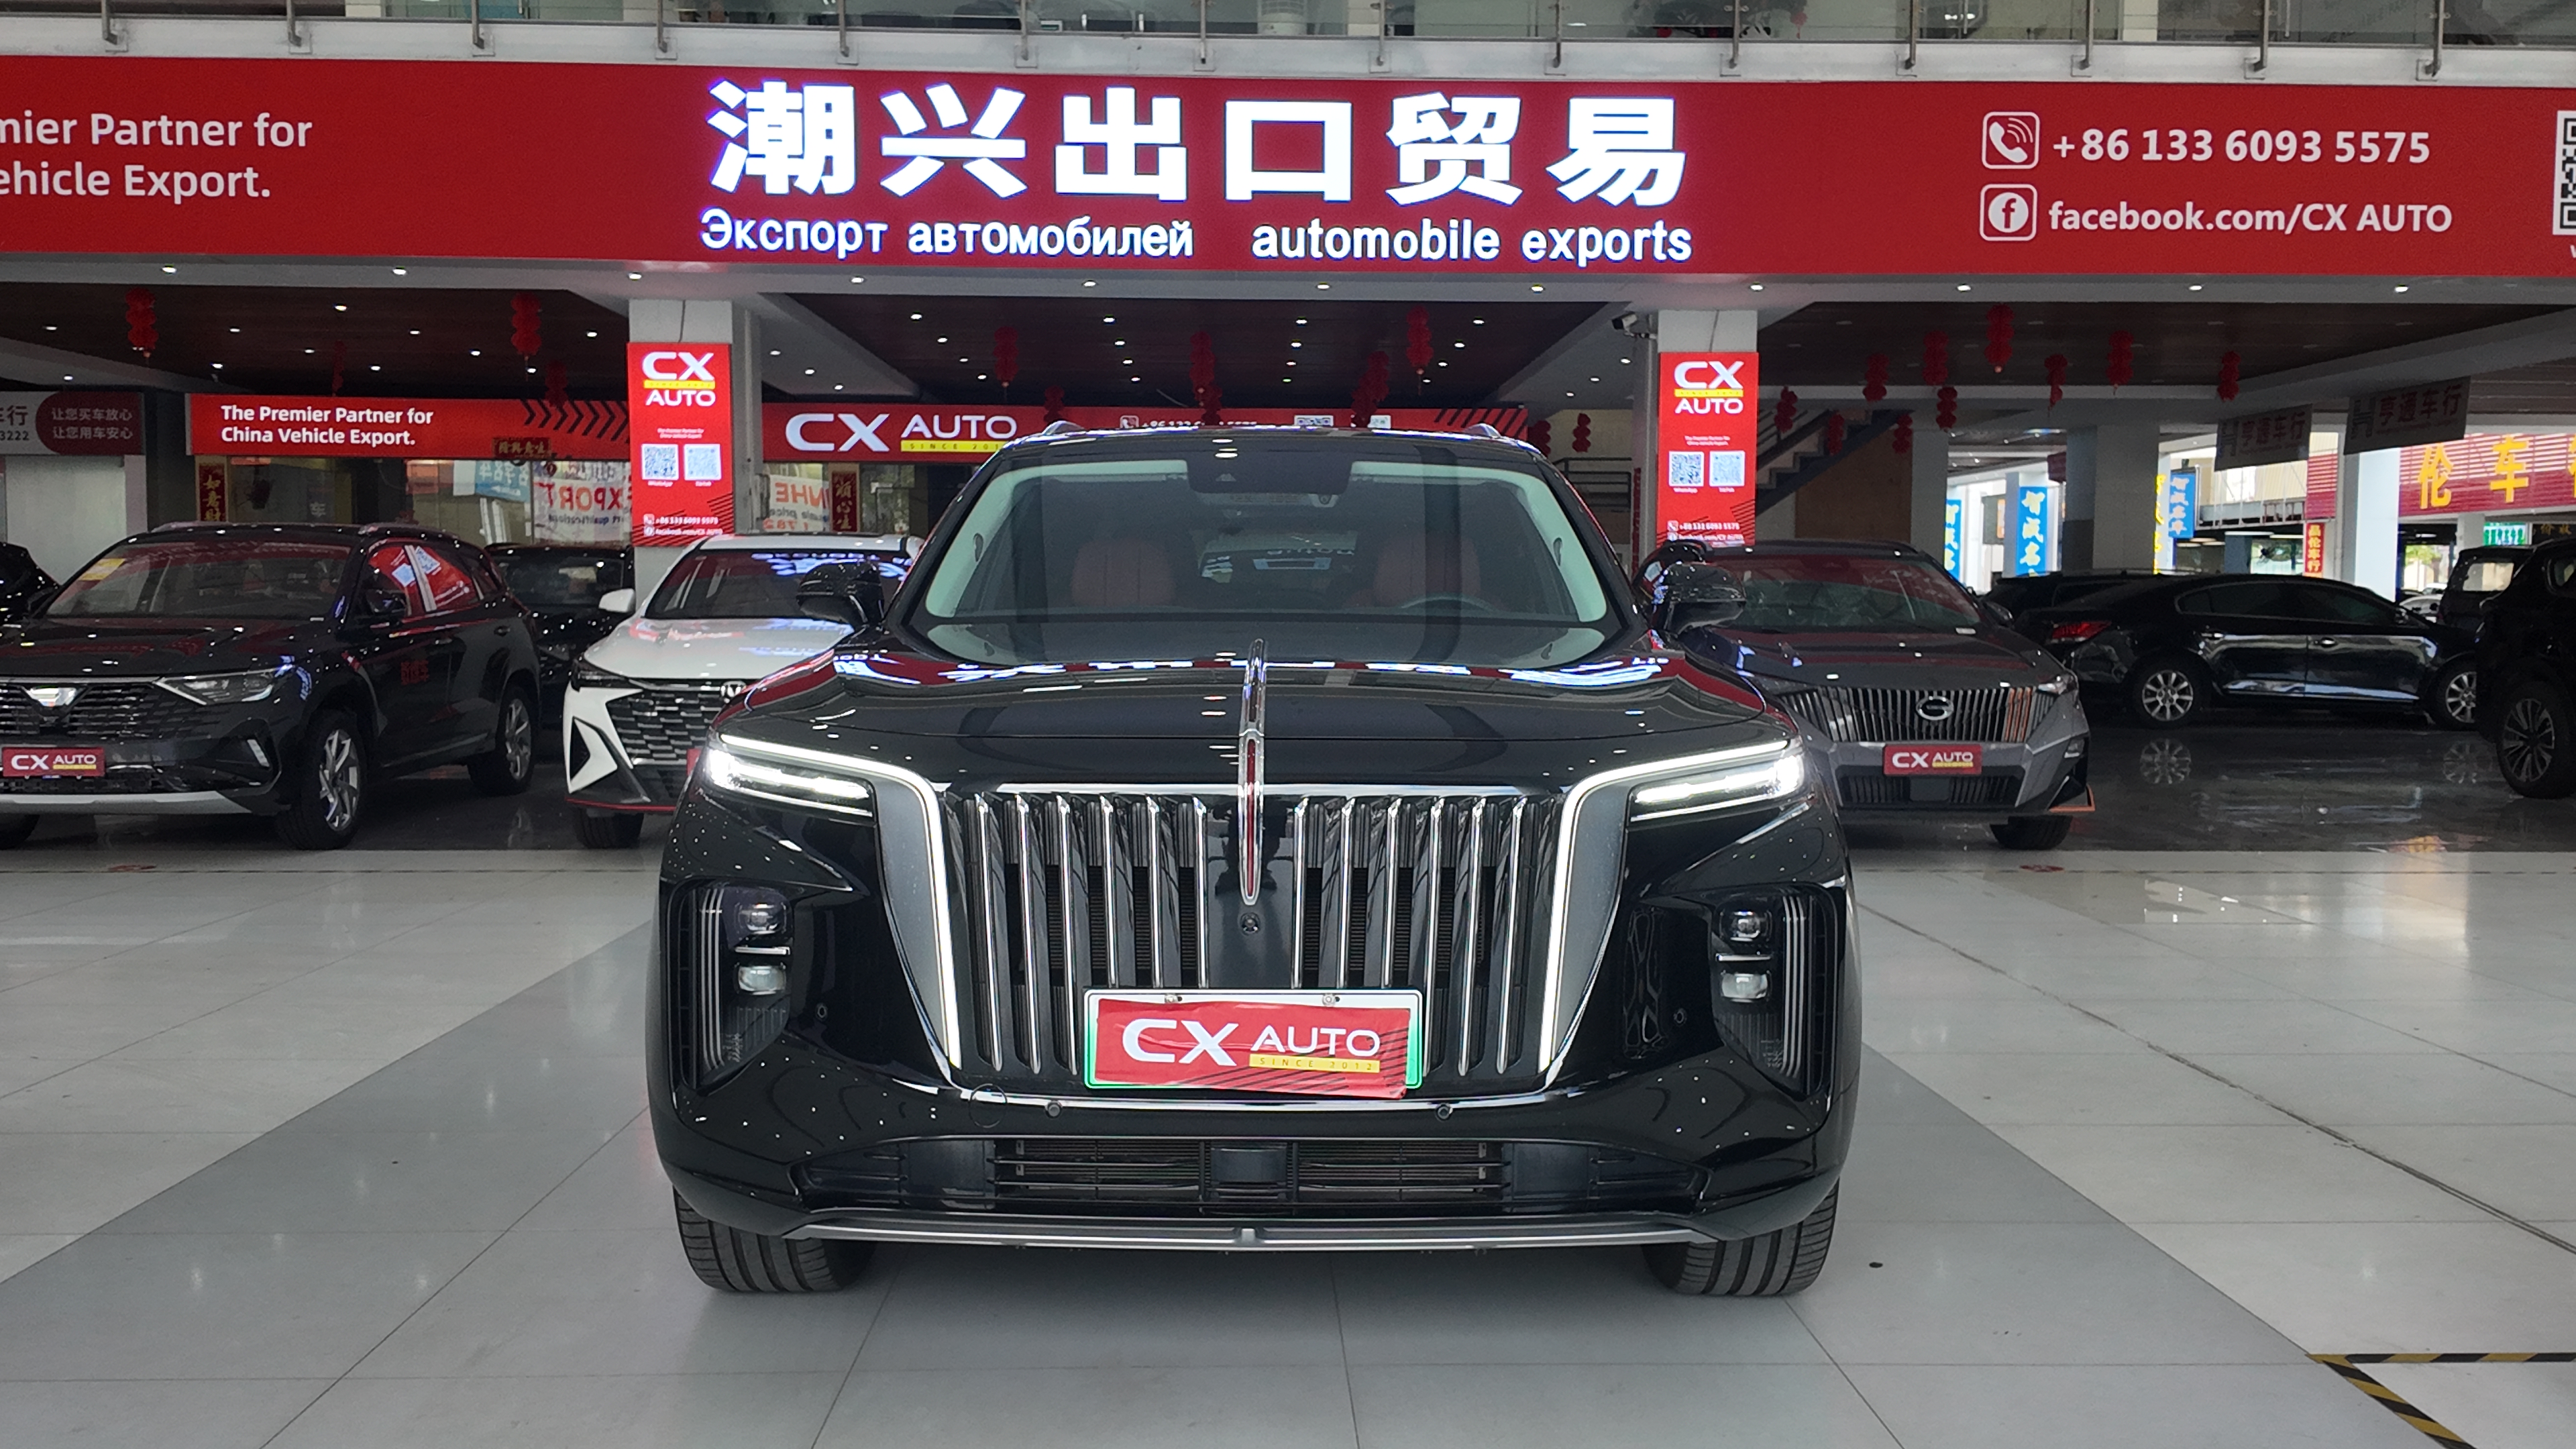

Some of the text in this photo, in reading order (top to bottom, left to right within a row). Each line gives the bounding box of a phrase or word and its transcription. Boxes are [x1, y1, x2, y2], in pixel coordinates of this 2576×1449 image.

[91, 113, 243, 146] Partner
[253, 112, 313, 147] for
[707, 80, 1686, 207] 潮兴出口贸易
[2053, 128, 2430, 163] +86 133 6093 5575
[124, 164, 270, 205] Export.
[2048, 201, 2453, 235] facebook.com/CX AUTO
[700, 207, 1193, 260] Экспорт автомобилей
[1252, 218, 1693, 268] automobile exports
[642, 351, 715, 380] CX
[1674, 360, 1744, 389] CX
[645, 388, 716, 407] AUTO
[1674, 397, 1744, 415] AUTO
[52, 407, 133, 421] 让您买车放心
[221, 405, 434, 425] The Premier Partner for
[52, 426, 133, 439] 让您用车安心
[221, 425, 416, 449] China Vehicle Export.
[786, 413, 1018, 452] CX AUTO
[11, 754, 97, 770] CX AUTO
[1892, 751, 1974, 768] CX AUTO
[1122, 1018, 1381, 1067] CX AUTO
[1259, 1057, 1372, 1071] SINCE 2012
